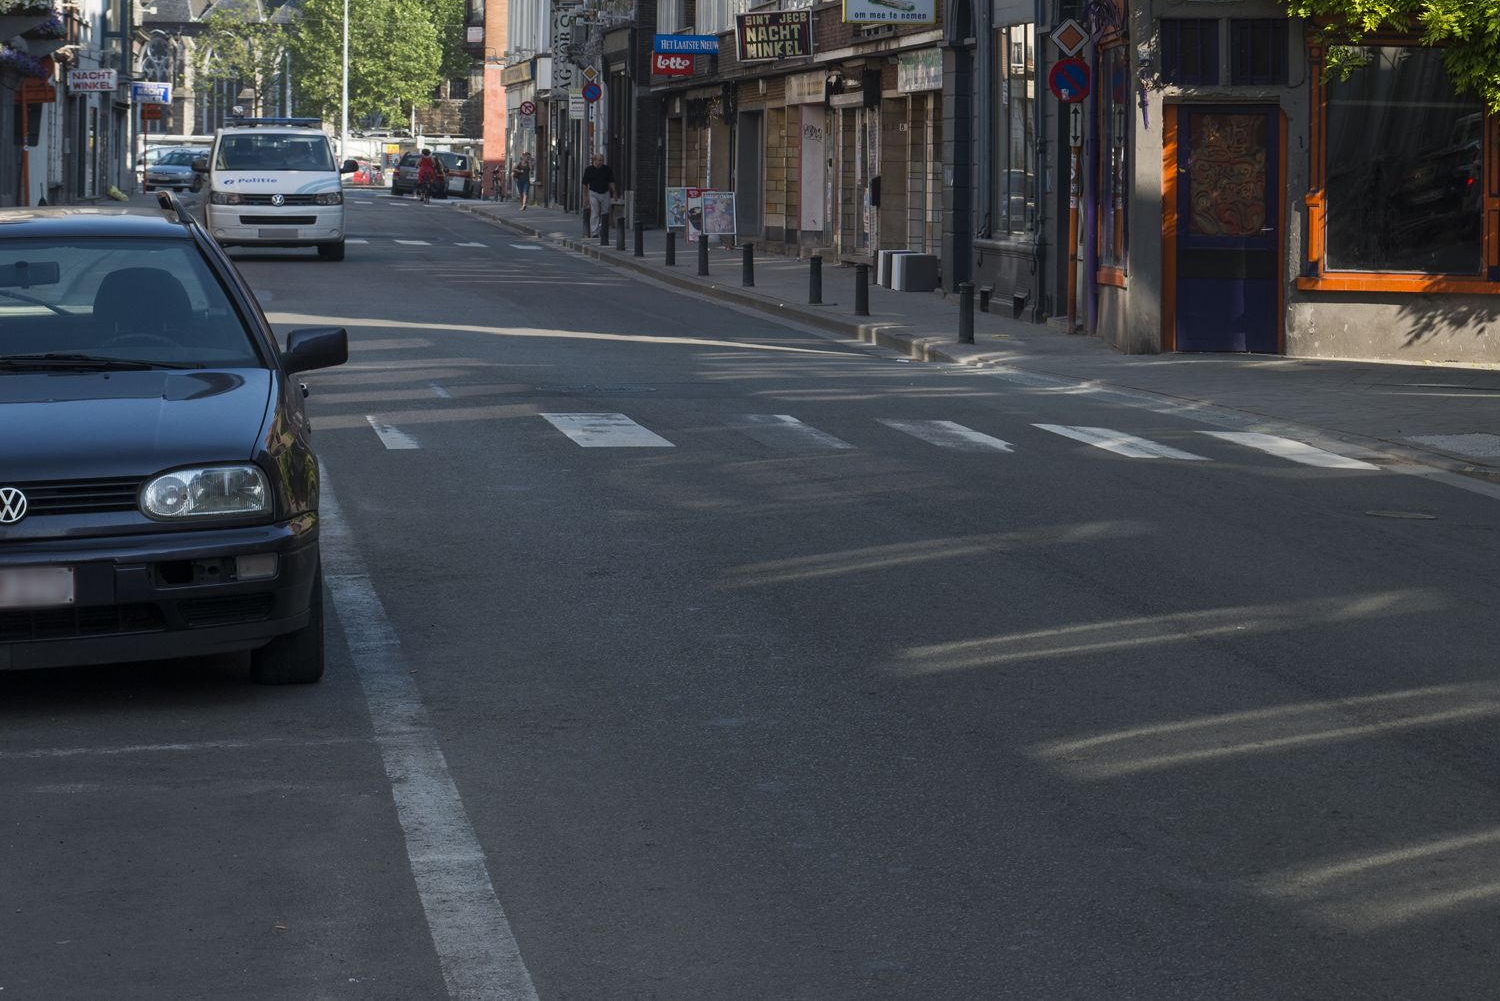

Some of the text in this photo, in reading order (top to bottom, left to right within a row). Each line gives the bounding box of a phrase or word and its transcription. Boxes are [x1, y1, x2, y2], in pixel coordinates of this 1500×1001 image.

[745, 14, 770, 26] SINT
[746, 24, 801, 42] NACHT
[661, 39, 720, 50] HET LAATSTE NIEUW
[746, 40, 803, 59] WINKEL
[656, 55, 690, 70] Lotto
[72, 71, 113, 80] NACHT
[72, 81, 113, 90] WINKEL
